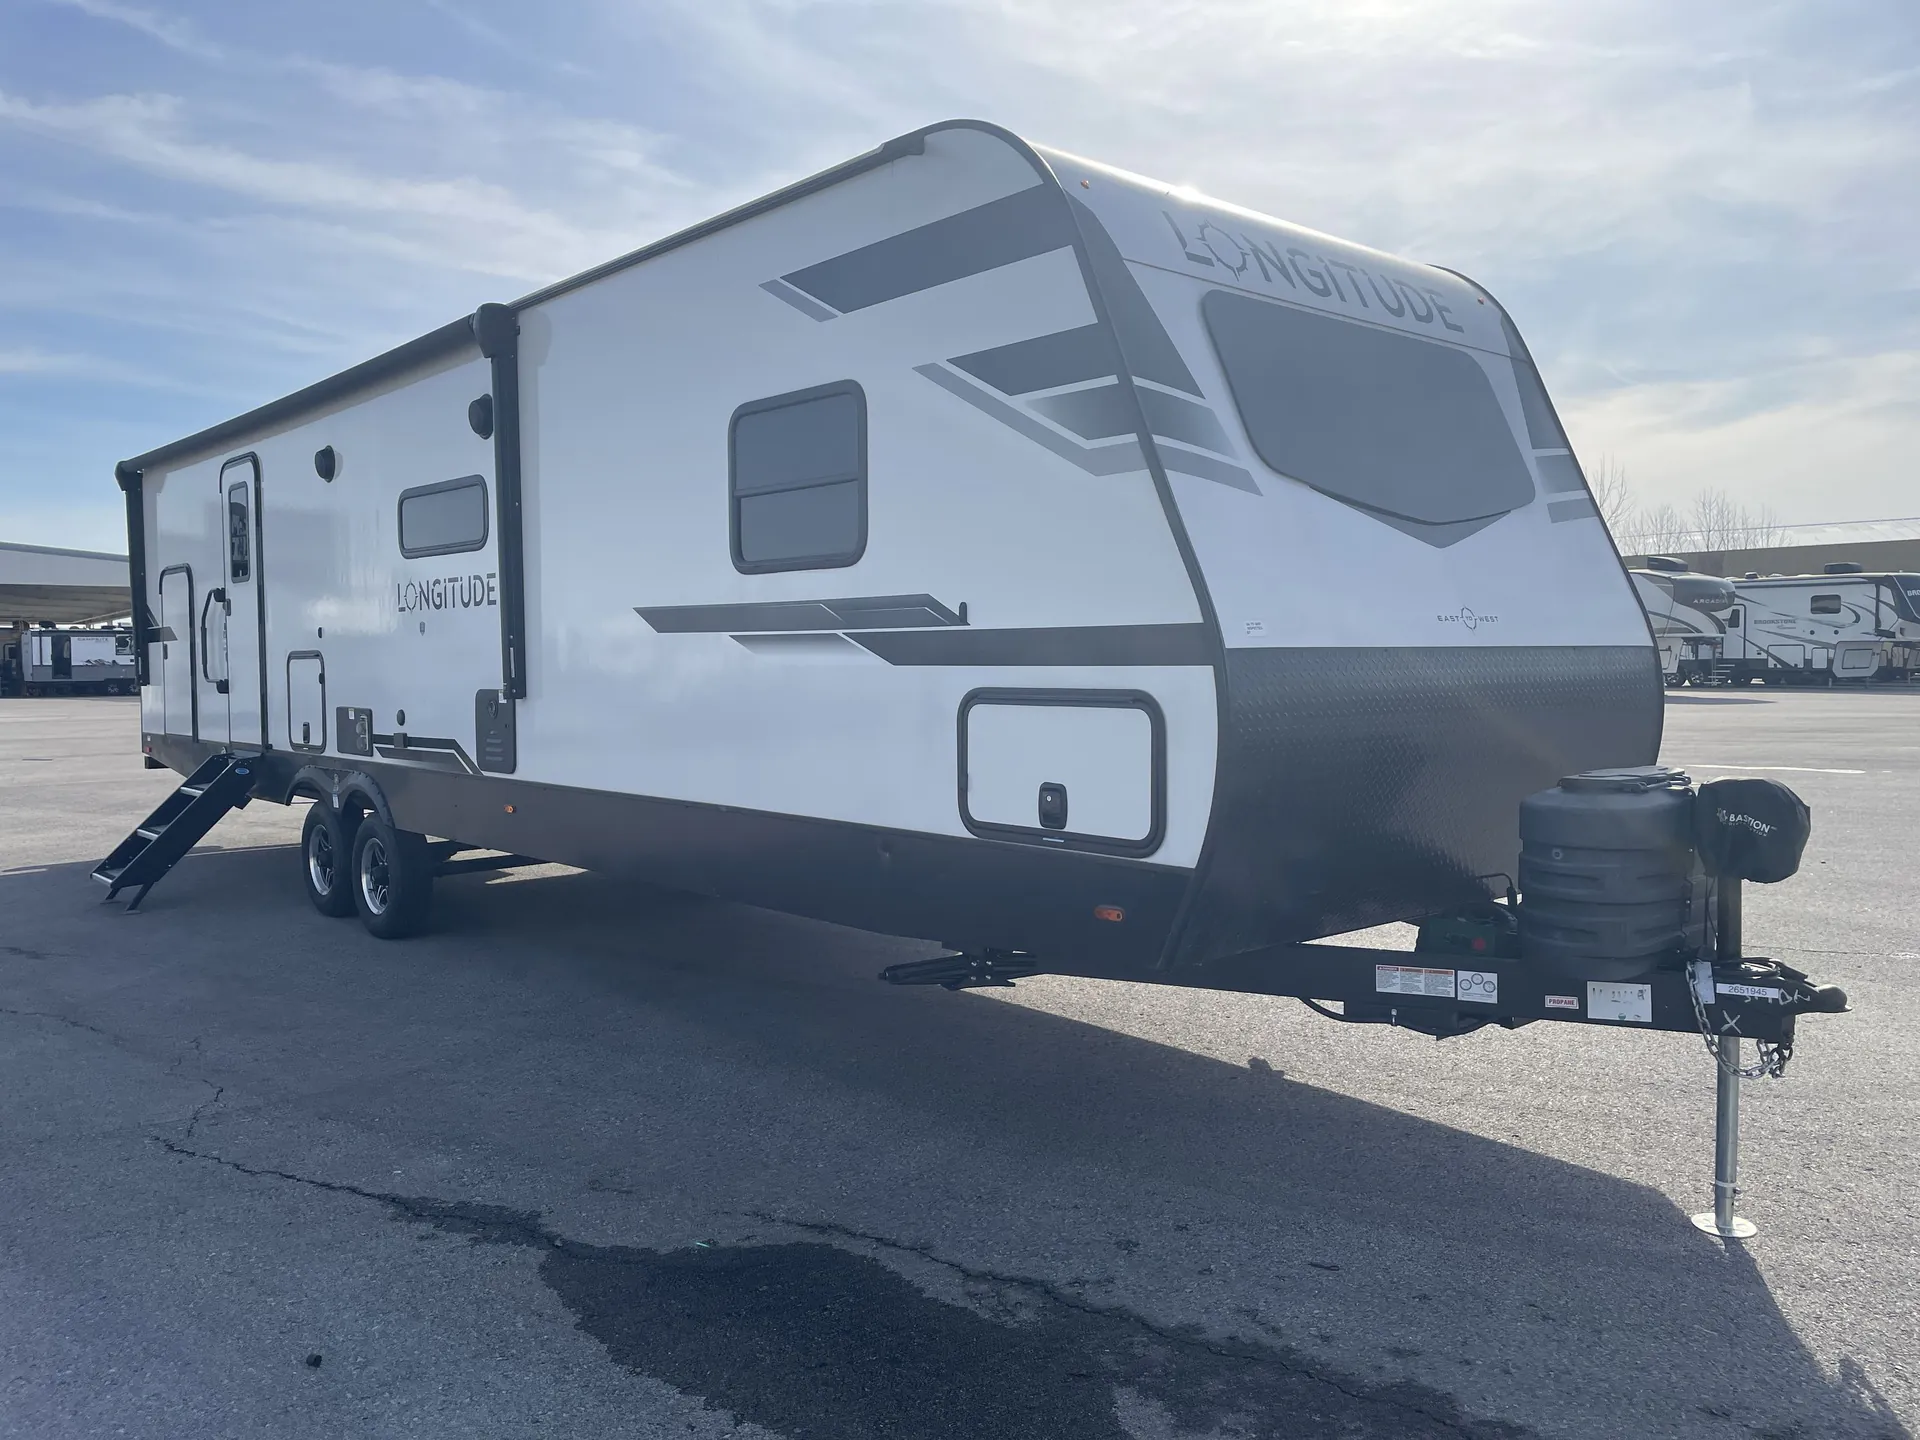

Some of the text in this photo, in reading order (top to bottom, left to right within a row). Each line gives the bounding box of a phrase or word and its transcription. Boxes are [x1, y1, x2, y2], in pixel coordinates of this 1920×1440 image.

[1162, 209, 1465, 334] LONGITUDE
[397, 572, 497, 613] LONGITUDE
[1729, 813, 1771, 833] BASTION
[1728, 985, 1768, 997] 2651945
[1548, 998, 1576, 1006] PROPANE
